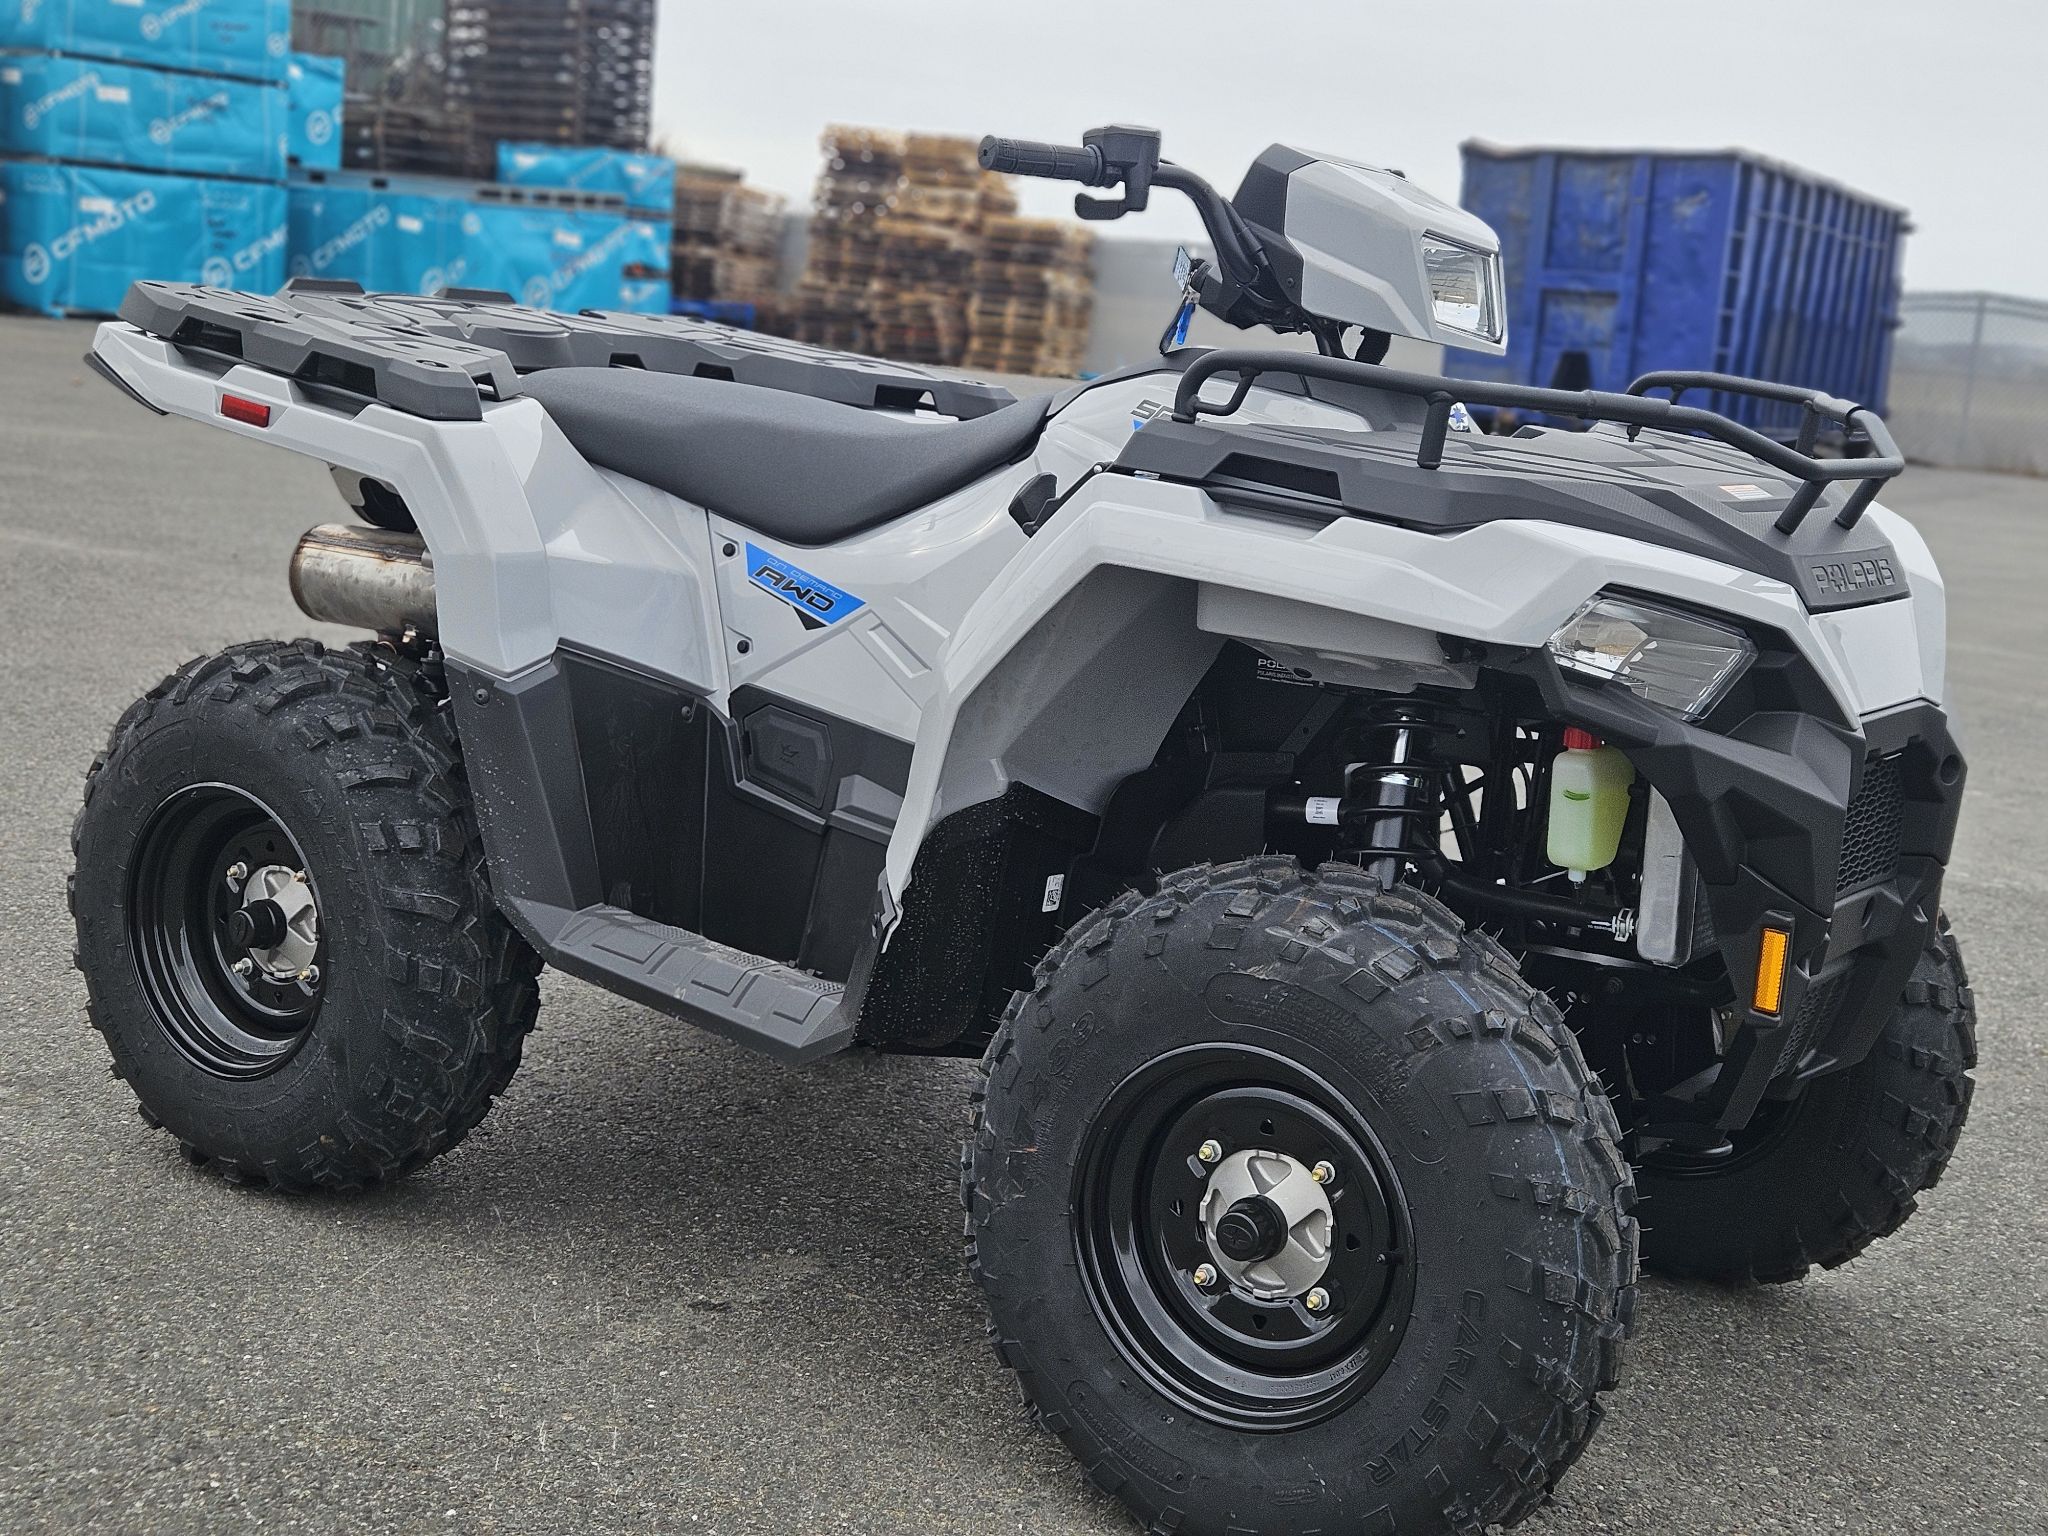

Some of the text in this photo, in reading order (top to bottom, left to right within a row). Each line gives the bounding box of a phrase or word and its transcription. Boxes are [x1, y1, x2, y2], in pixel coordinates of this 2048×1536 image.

[51, 189, 155, 260] CFMOTO
[311, 203, 391, 270] CFMOTO
[754, 565, 836, 613] AWD
[767, 557, 843, 600] ON DEMAND
[1811, 558, 1896, 595] POLARIS
[1361, 1288, 1486, 1487] CARLSTAR
